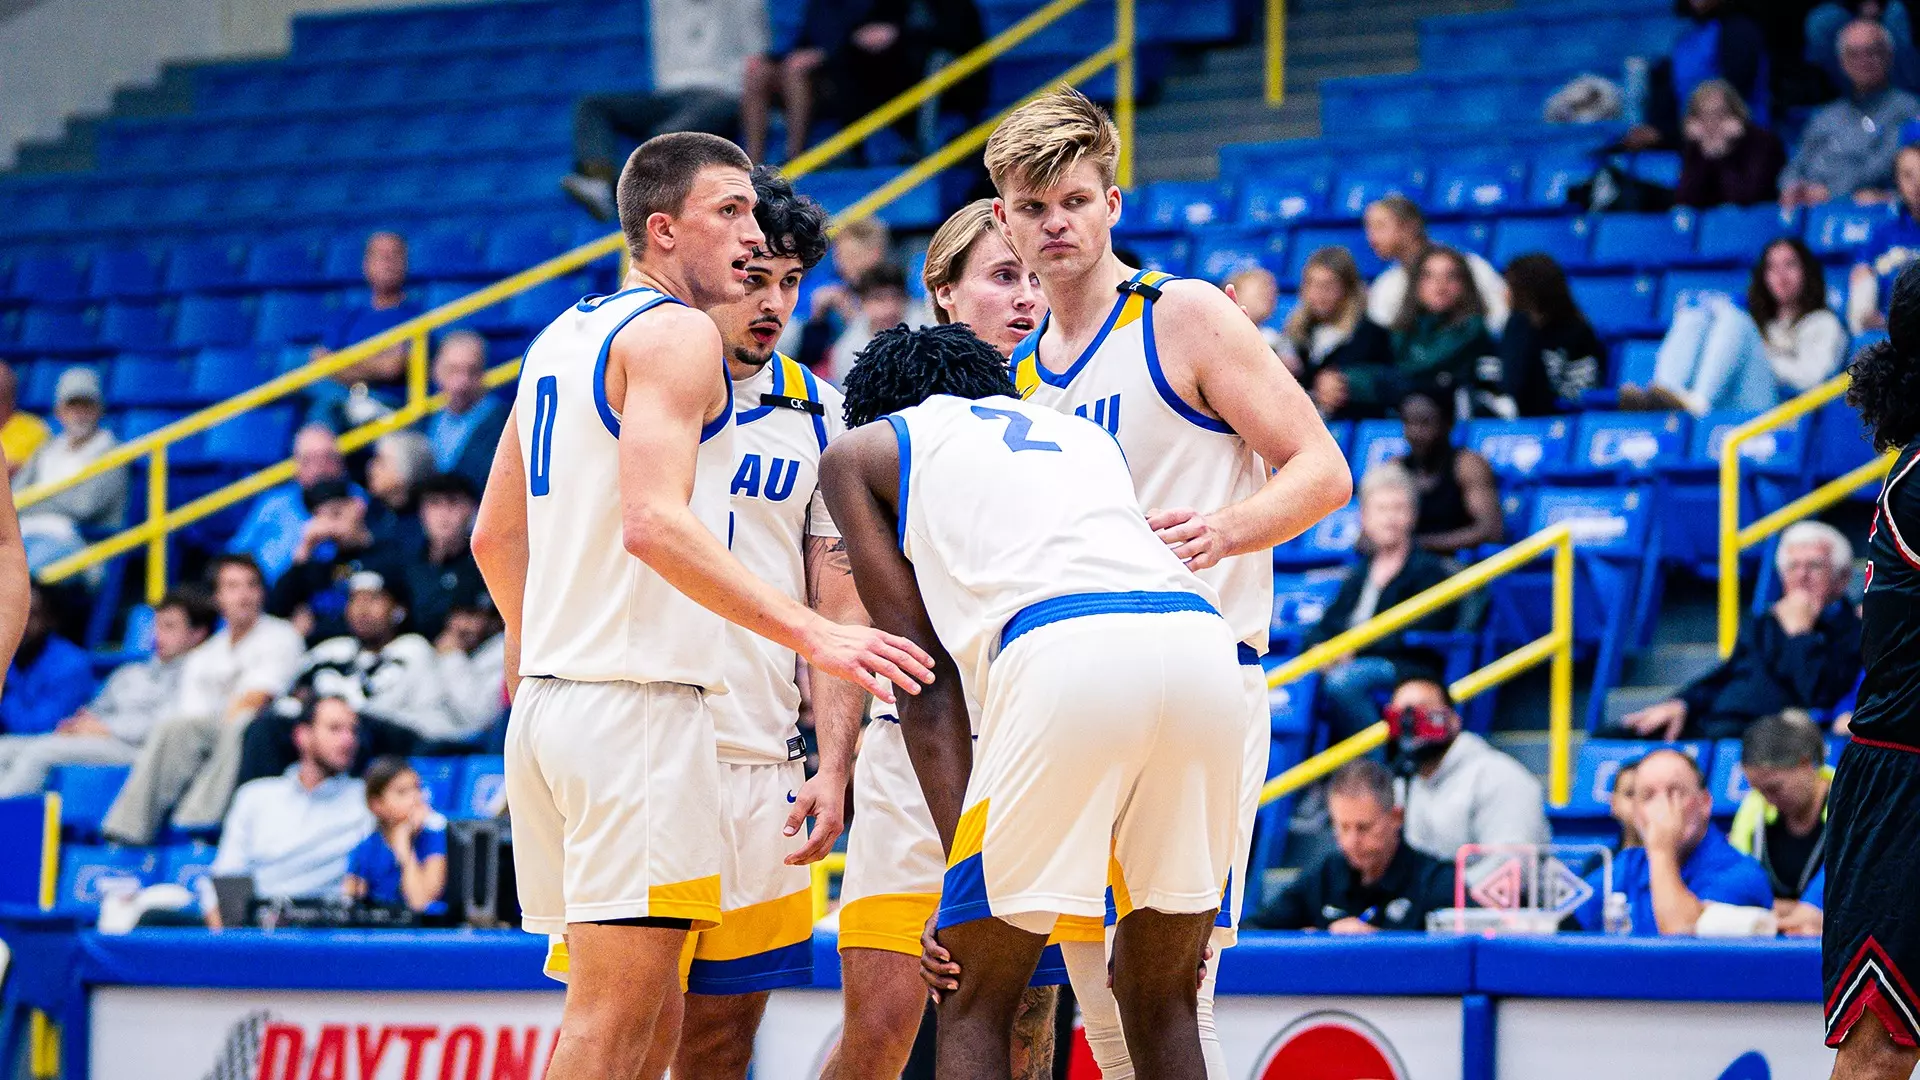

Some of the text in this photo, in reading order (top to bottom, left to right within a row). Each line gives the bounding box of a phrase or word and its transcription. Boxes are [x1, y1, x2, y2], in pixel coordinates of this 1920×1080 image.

[790, 399, 805, 410] CK
[970, 405, 1063, 453] 2
[530, 375, 558, 497] 0
[256, 1023, 564, 1080] DAYTON
